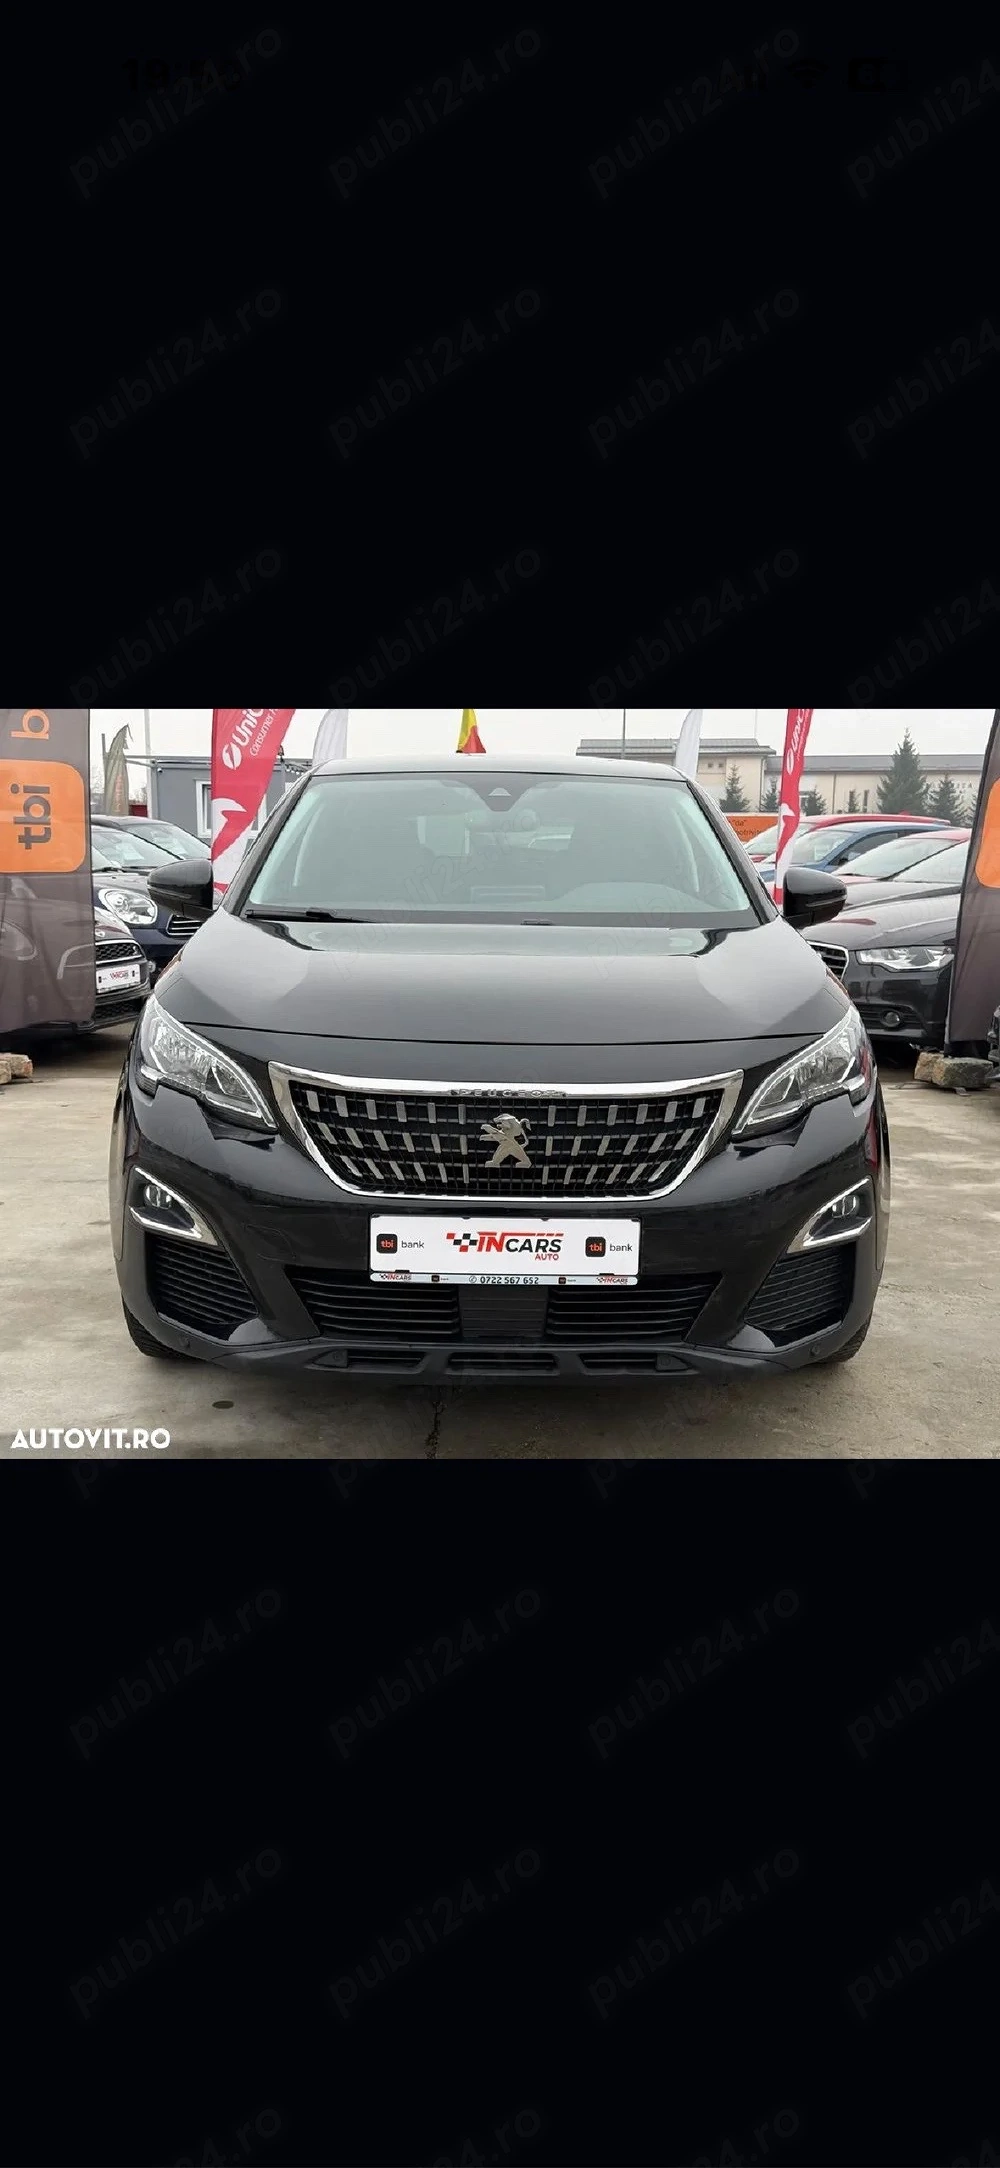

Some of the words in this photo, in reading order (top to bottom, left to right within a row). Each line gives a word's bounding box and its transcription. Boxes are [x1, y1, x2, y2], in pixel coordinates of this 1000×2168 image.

[10, 783, 51, 849] tbi
[459, 1088, 556, 1098] PEUGEOT
[381, 1240, 394, 1249] tbi
[401, 1240, 425, 1249] bank
[476, 1231, 563, 1253] INCARS
[589, 1242, 603, 1252] tbi
[609, 1243, 633, 1252] bank
[534, 1253, 560, 1261] AUTO
[480, 1276, 502, 1284] 0722
[504, 1276, 520, 1285] 567
[523, 1276, 539, 1285] 652
